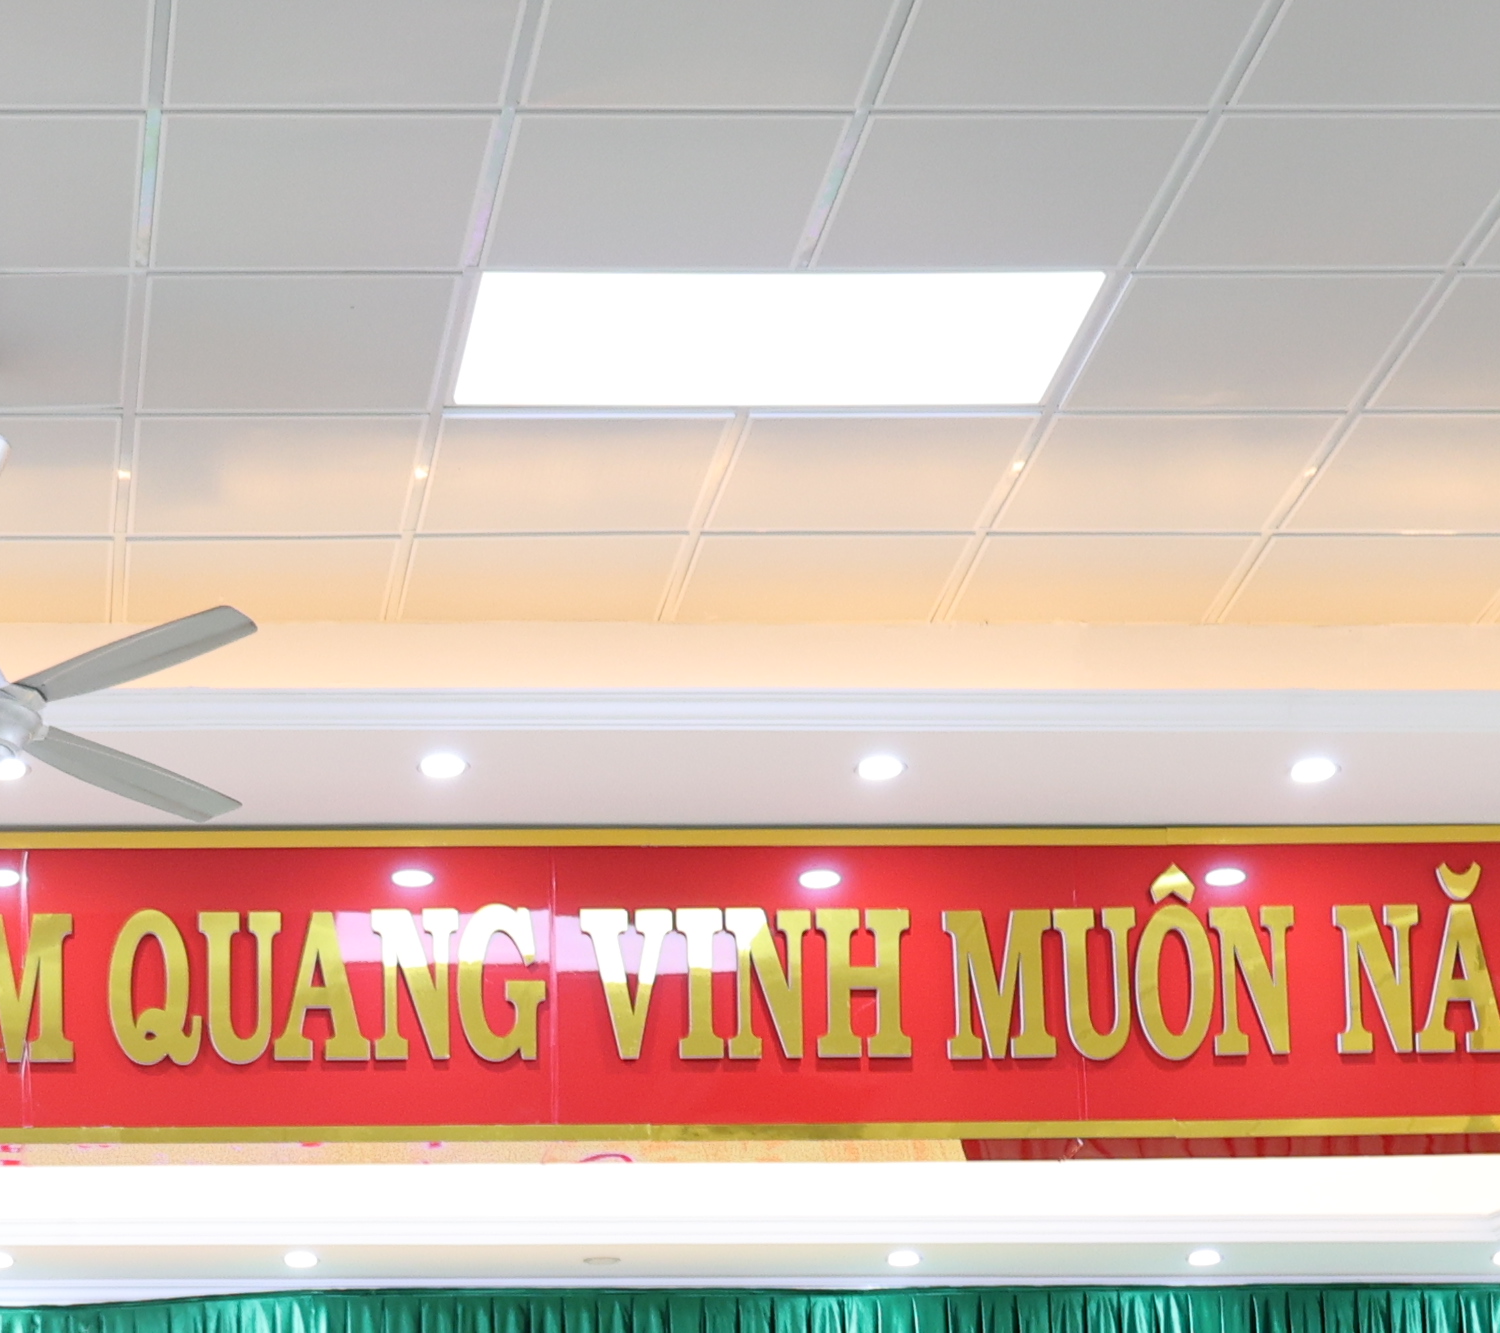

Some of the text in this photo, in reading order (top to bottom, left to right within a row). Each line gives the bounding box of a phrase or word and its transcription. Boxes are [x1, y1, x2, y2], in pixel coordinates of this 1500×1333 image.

[109, 903, 547, 1066] QUANG
[579, 908, 913, 1061] VINH
[941, 862, 1294, 1061] MUÔN
